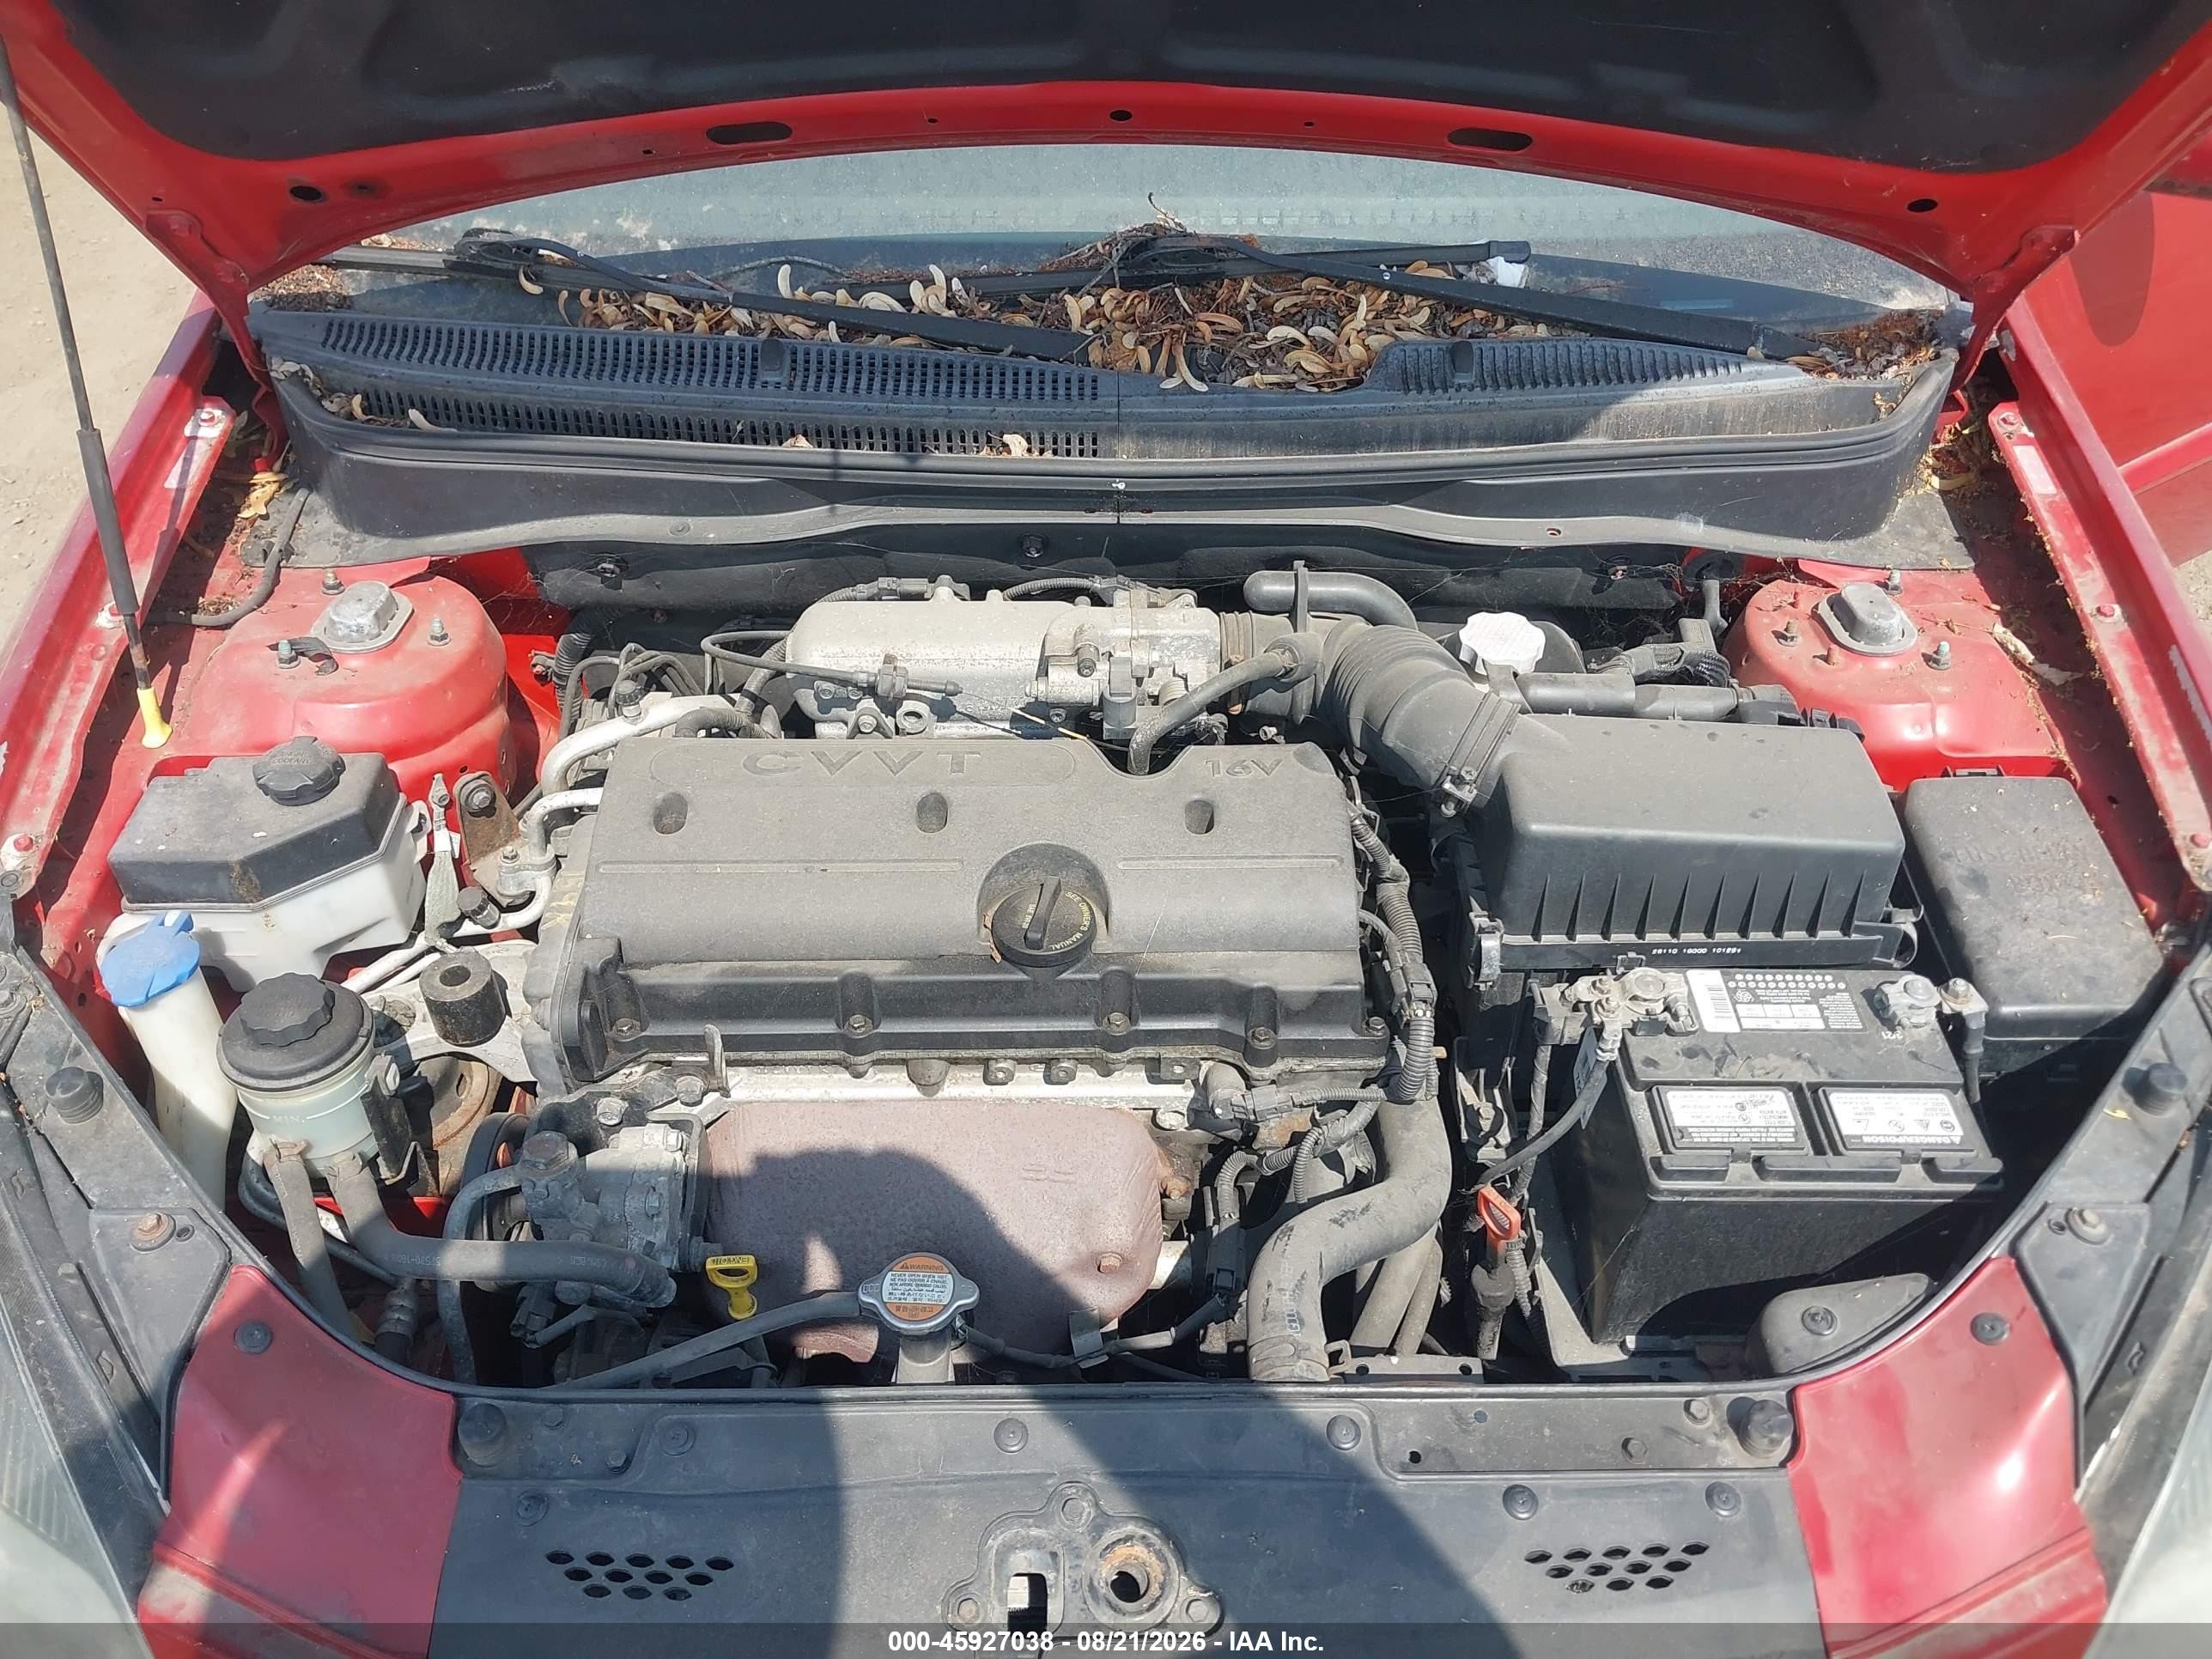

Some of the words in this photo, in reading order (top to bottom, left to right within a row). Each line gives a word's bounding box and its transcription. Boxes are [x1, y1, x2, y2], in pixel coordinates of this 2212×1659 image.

[742, 749, 981, 777] CVVT
[1204, 758, 1283, 778] 16V
[1065, 891, 1082, 903] SEE
[1079, 902, 1091, 933] OWNER'S
[1050, 932, 1083, 951] MANUAL
